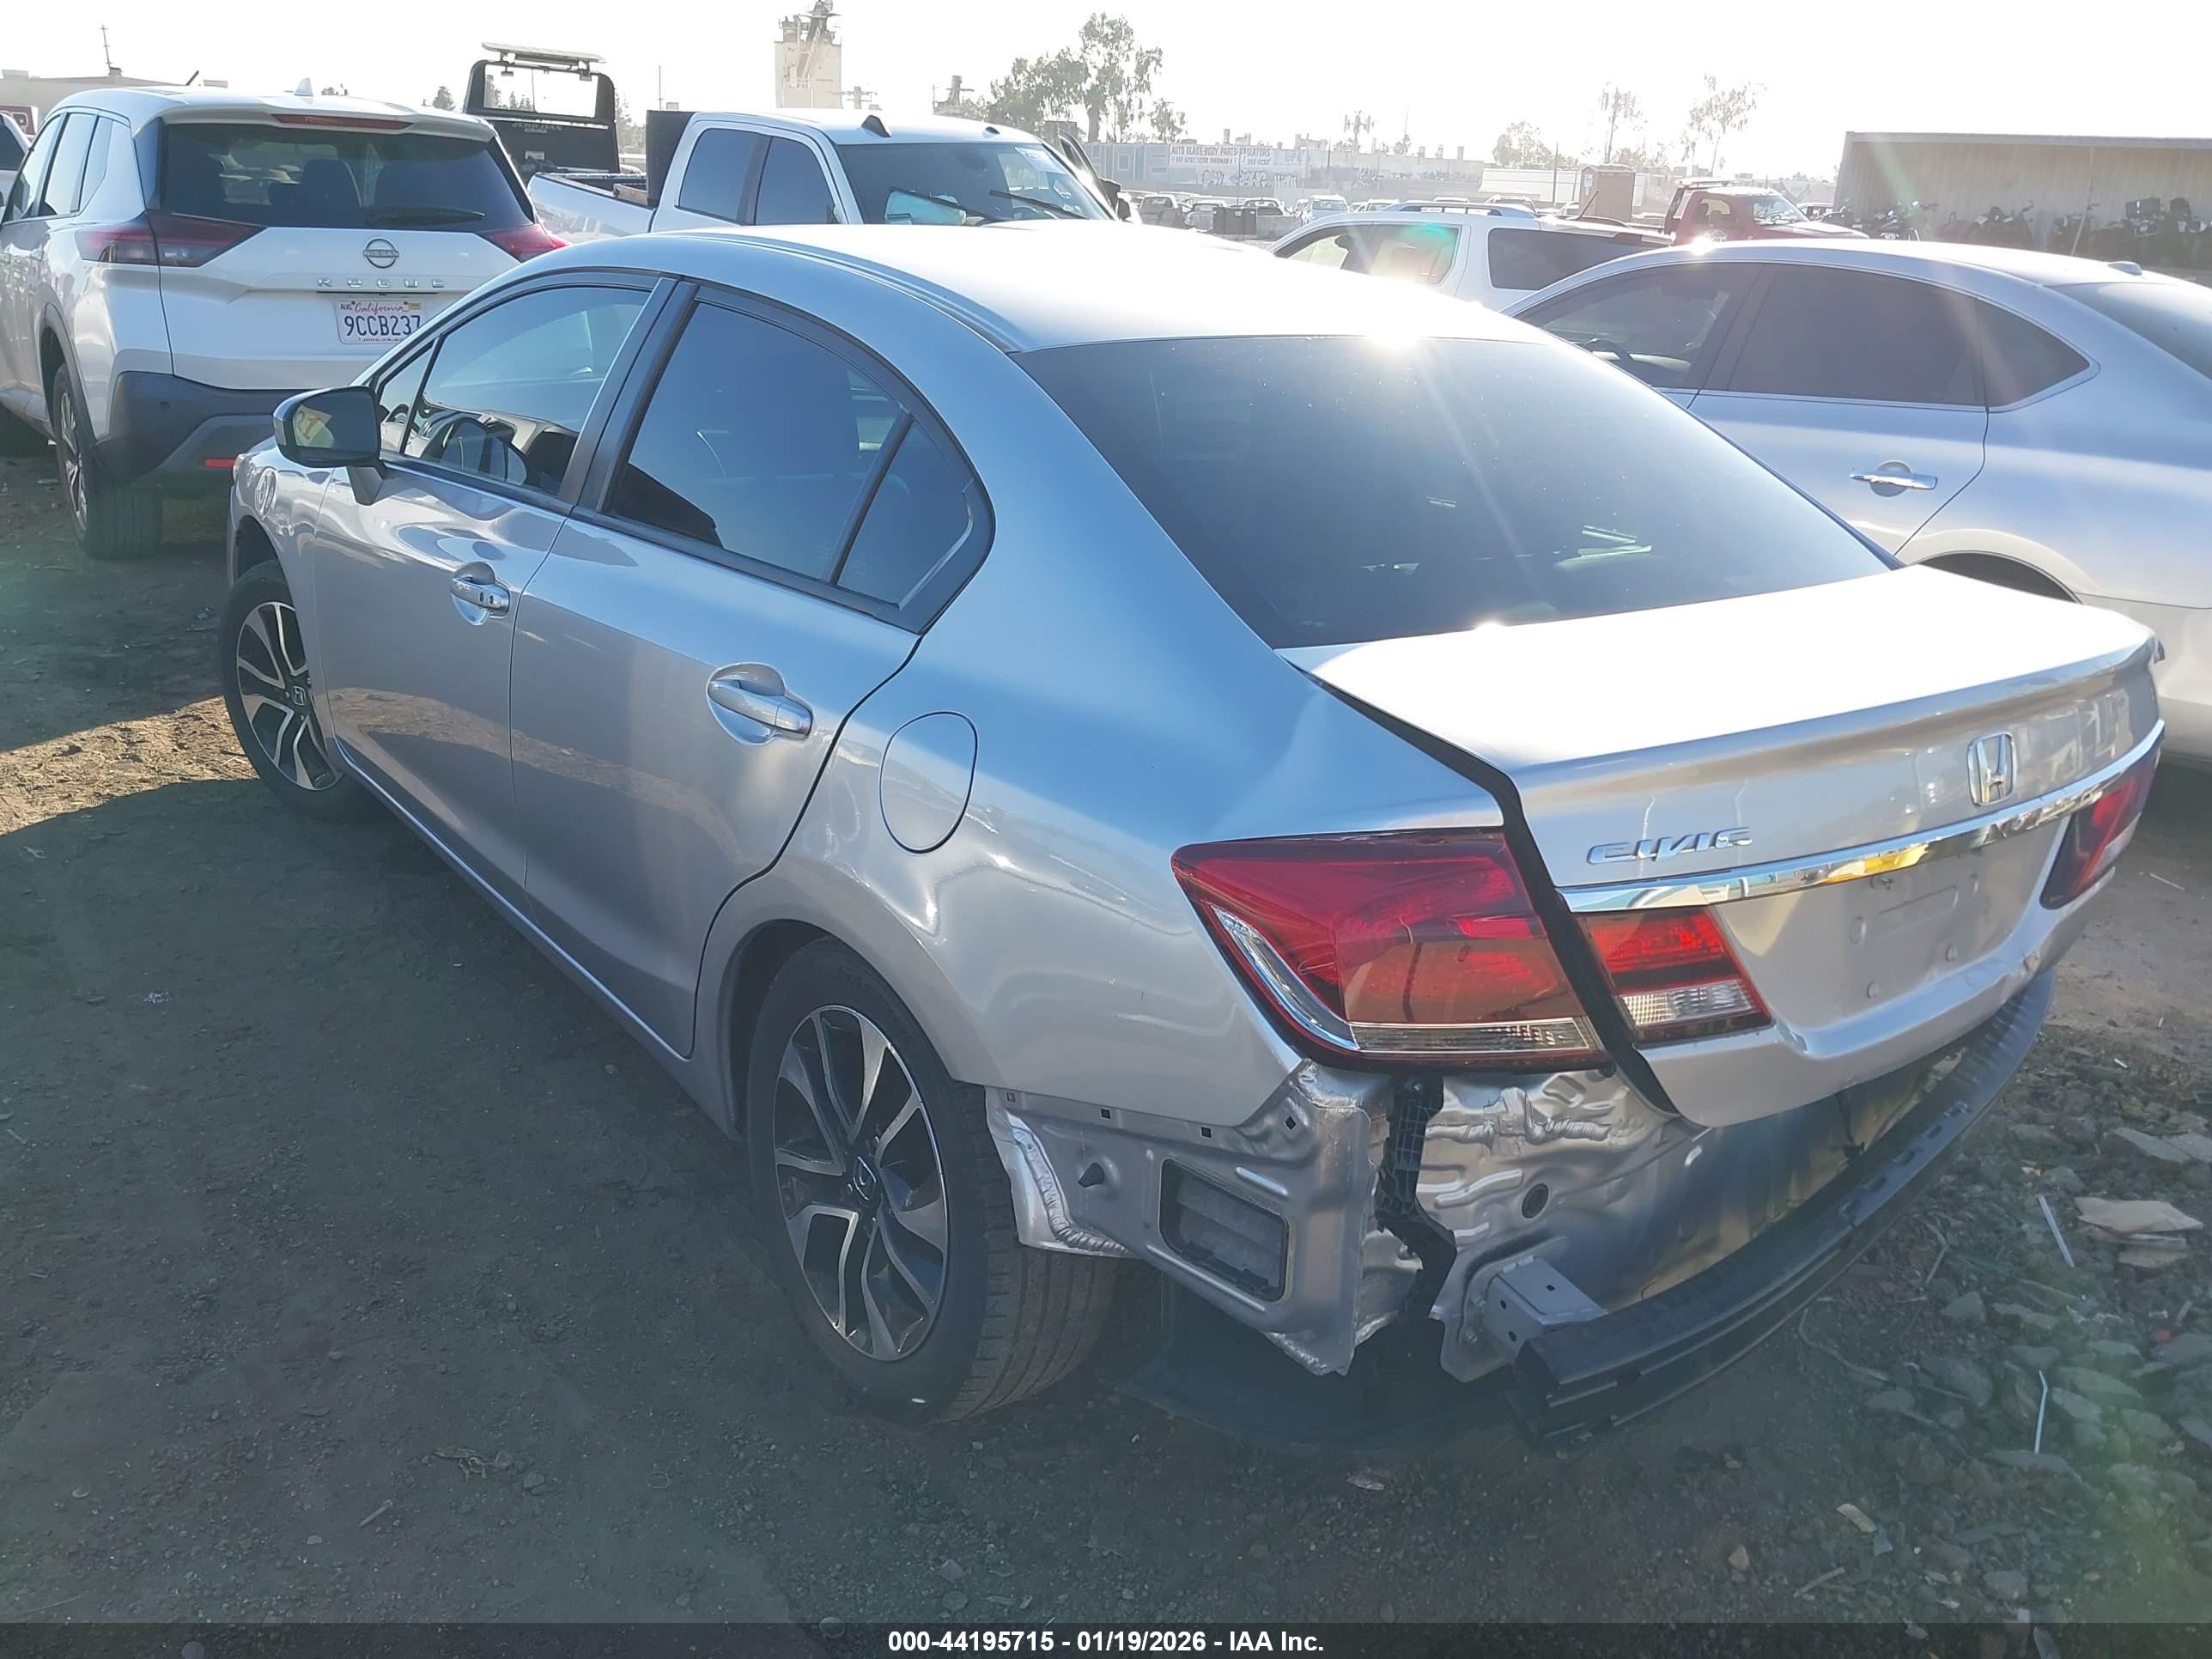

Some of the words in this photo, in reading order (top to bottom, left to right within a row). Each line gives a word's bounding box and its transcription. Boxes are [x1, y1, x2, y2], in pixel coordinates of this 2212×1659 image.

[1171, 146, 1185, 155] AUTO
[318, 278, 445, 288] ROGUE
[355, 301, 409, 315] California
[344, 315, 421, 336] 9CCB237
[1587, 827, 1753, 865] CIVIC
